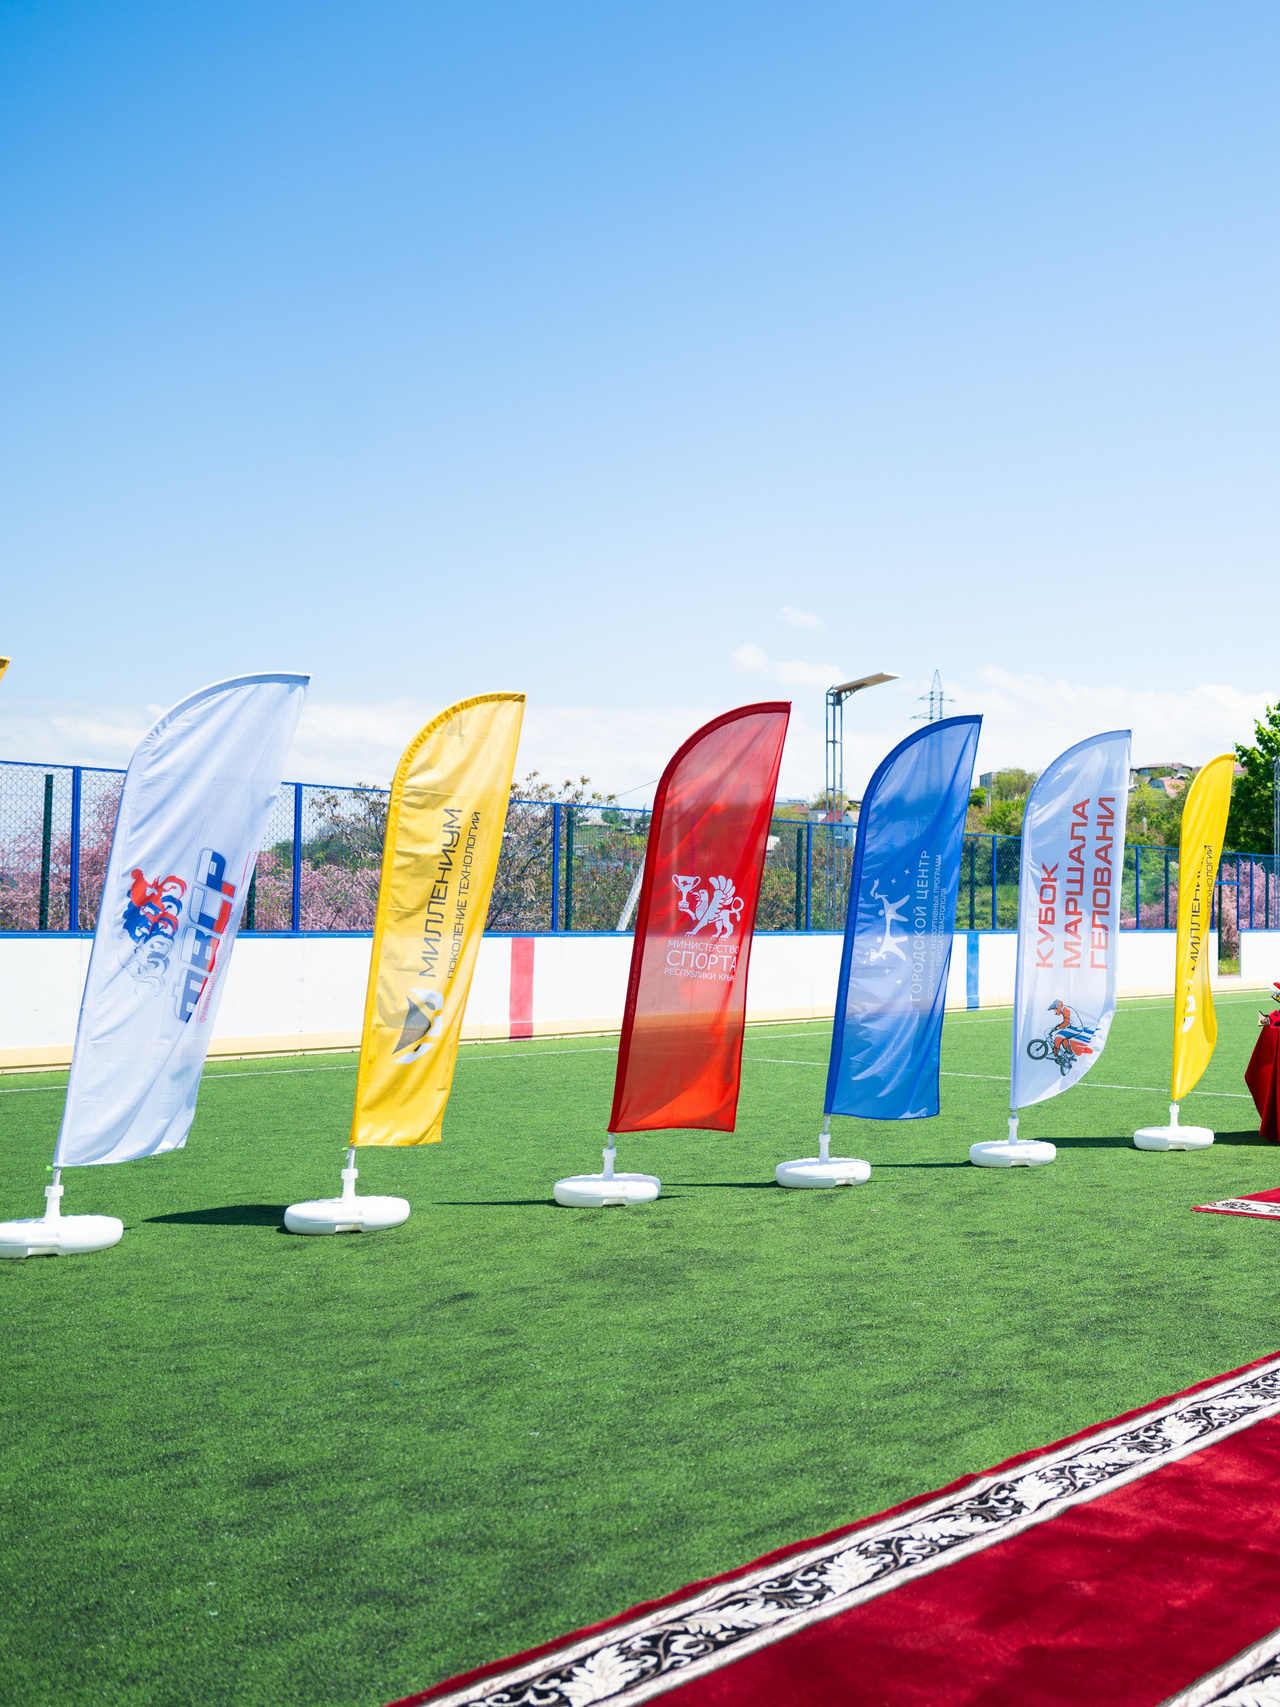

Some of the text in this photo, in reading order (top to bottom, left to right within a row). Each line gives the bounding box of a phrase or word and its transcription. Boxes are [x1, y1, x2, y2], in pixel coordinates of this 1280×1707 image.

[418, 808, 462, 978] МИЛЛЕНИУМ
[447, 811, 481, 979] ПОКОЛЕНИЕ ТЕХНОЛОГИЙ
[933, 854, 942, 893] ПРОГРАММ
[1063, 798, 1090, 969] МАРШАЛА
[1090, 797, 1115, 969] ГЕЛОВАНИ
[910, 850, 930, 1002] ГОРОДСКОЙ ЦЕНТР
[931, 892, 940, 943] СПОРТИВНЫХ
[938, 888, 947, 939] СЕВАСТОПОЛЯ
[1036, 862, 1059, 968] КУБОК
[666, 949, 737, 972] СПОРТА
[667, 939, 739, 954] МИНИСТЕРСТВО
[664, 967, 716, 980] РЕСПУБЛИКИ
[927, 951, 936, 999] СОЦИАЛЬНЫХ
